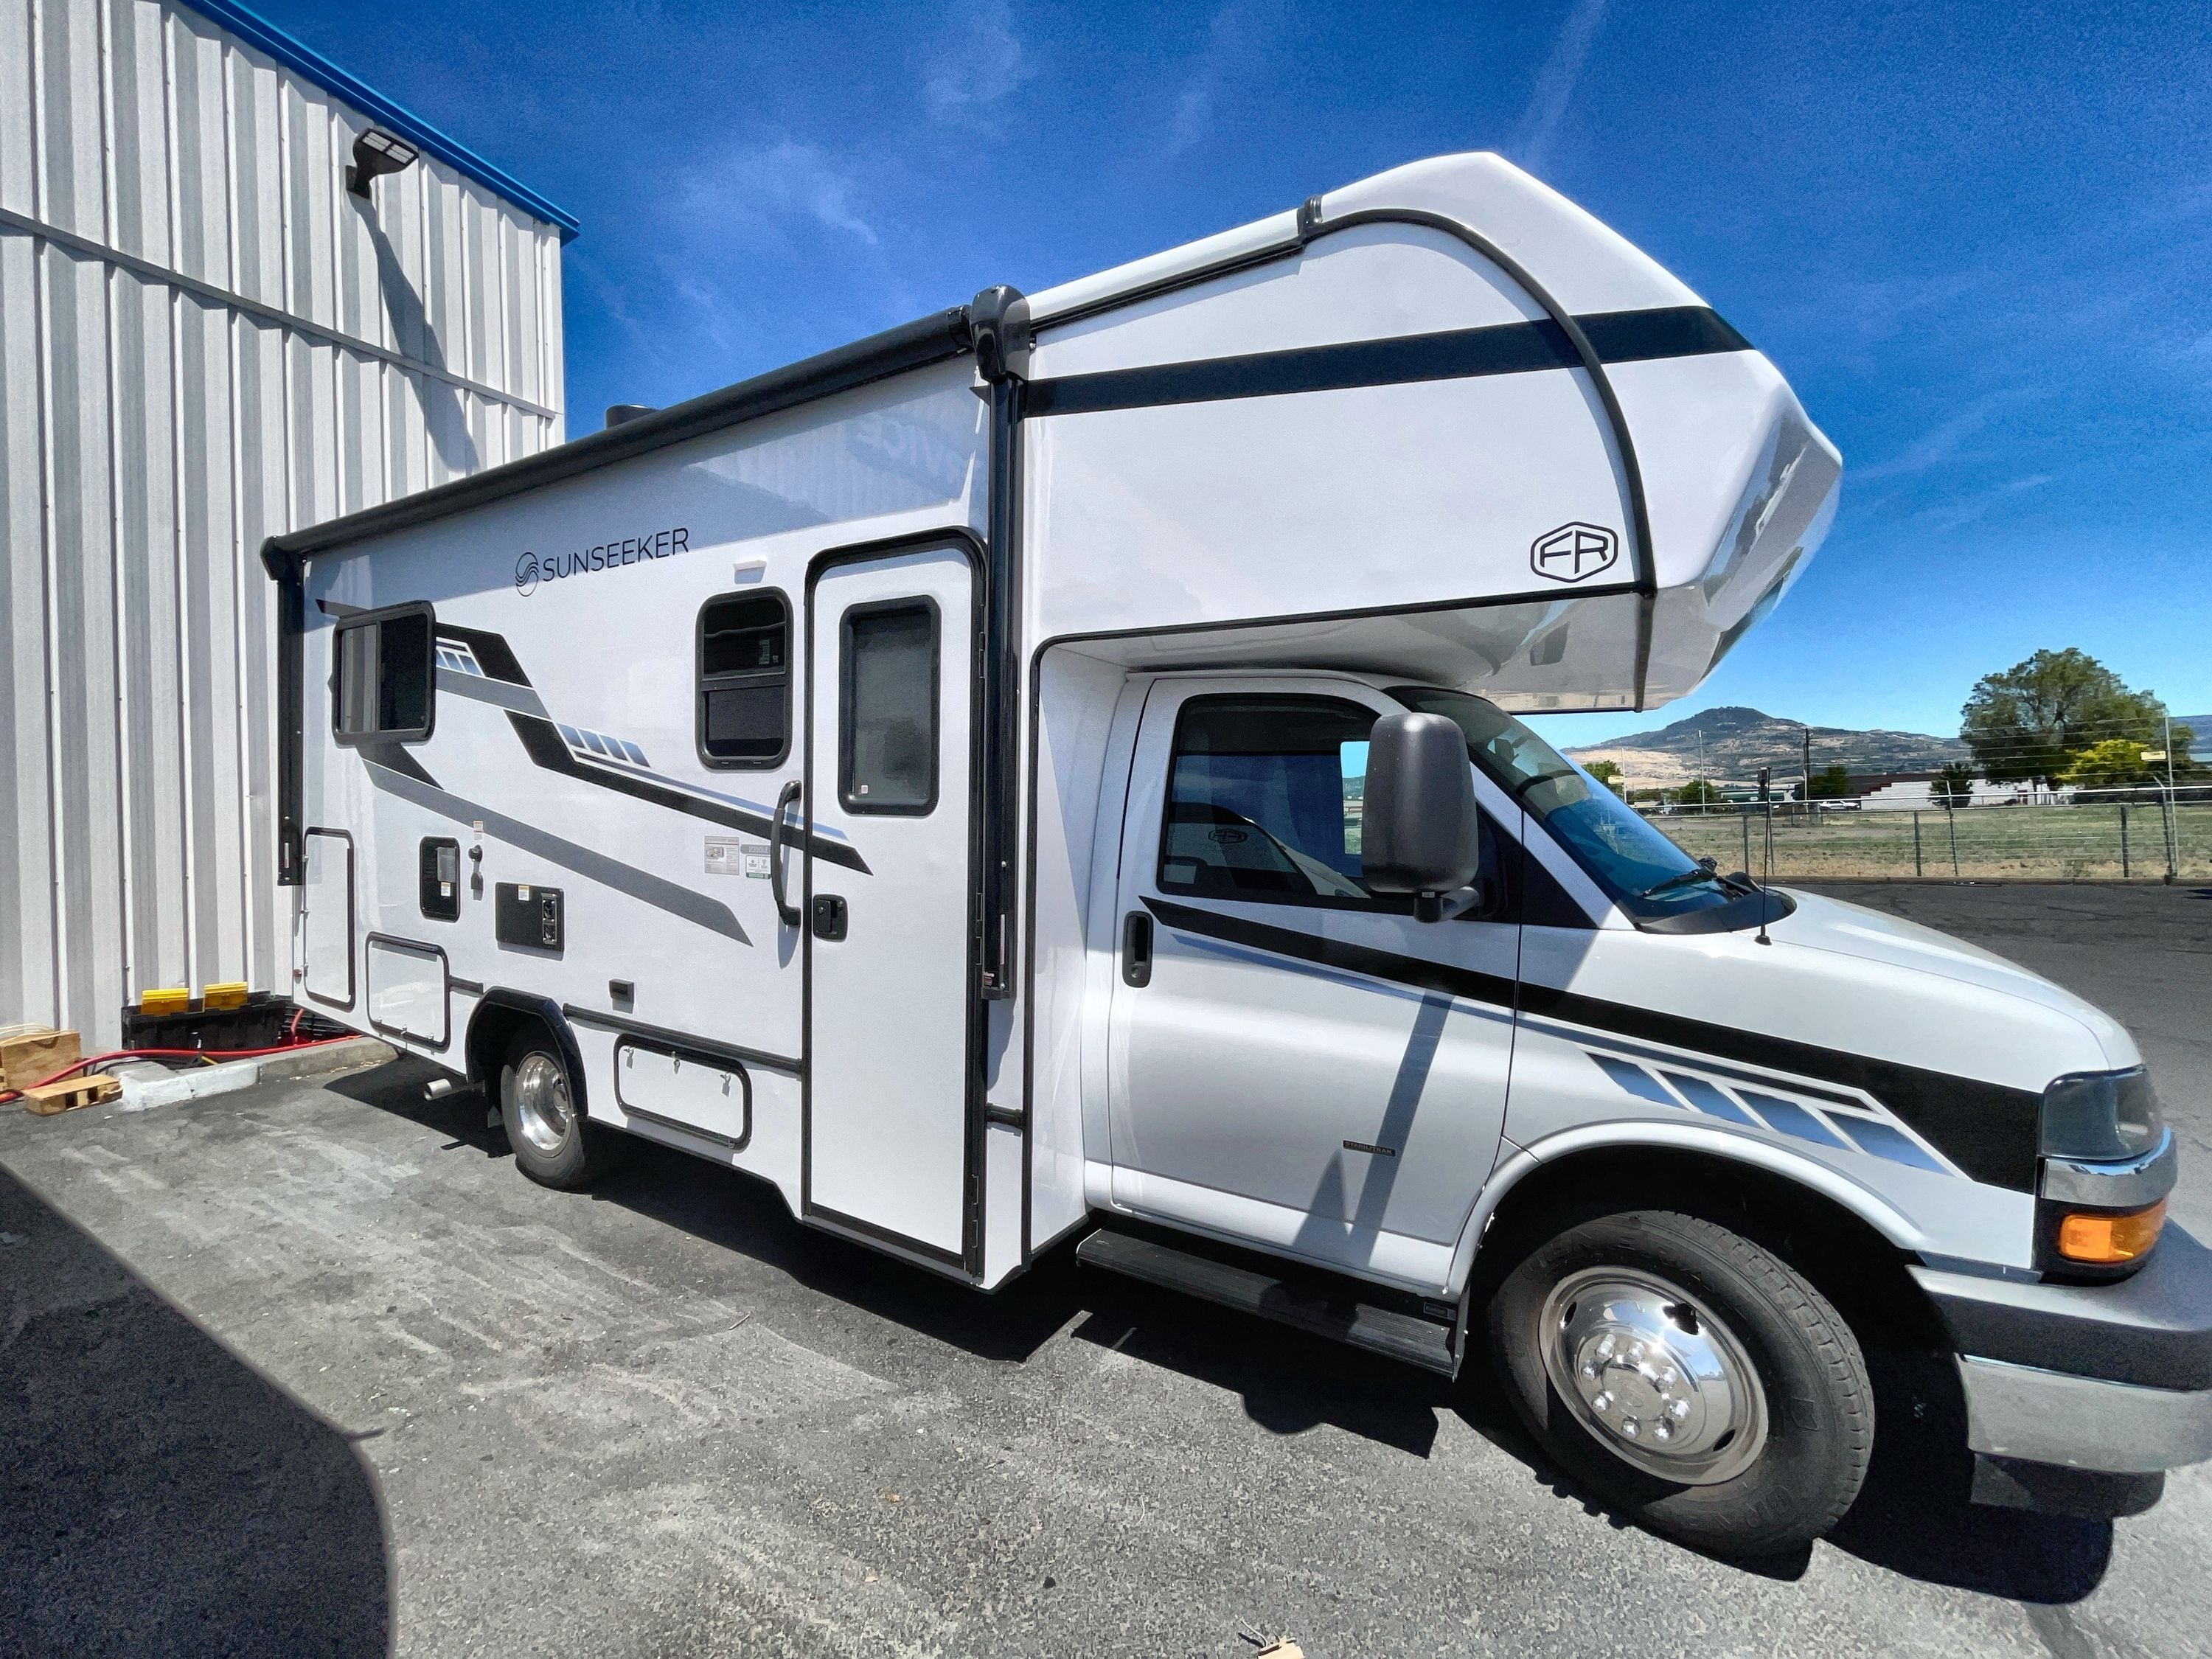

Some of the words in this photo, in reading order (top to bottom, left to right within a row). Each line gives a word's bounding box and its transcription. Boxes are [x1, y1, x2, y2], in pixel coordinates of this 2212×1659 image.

[543, 527, 689, 582] SUNSEEKER
[1540, 530, 1609, 574] FR
[1345, 1141, 1392, 1155] STABILITRAK
